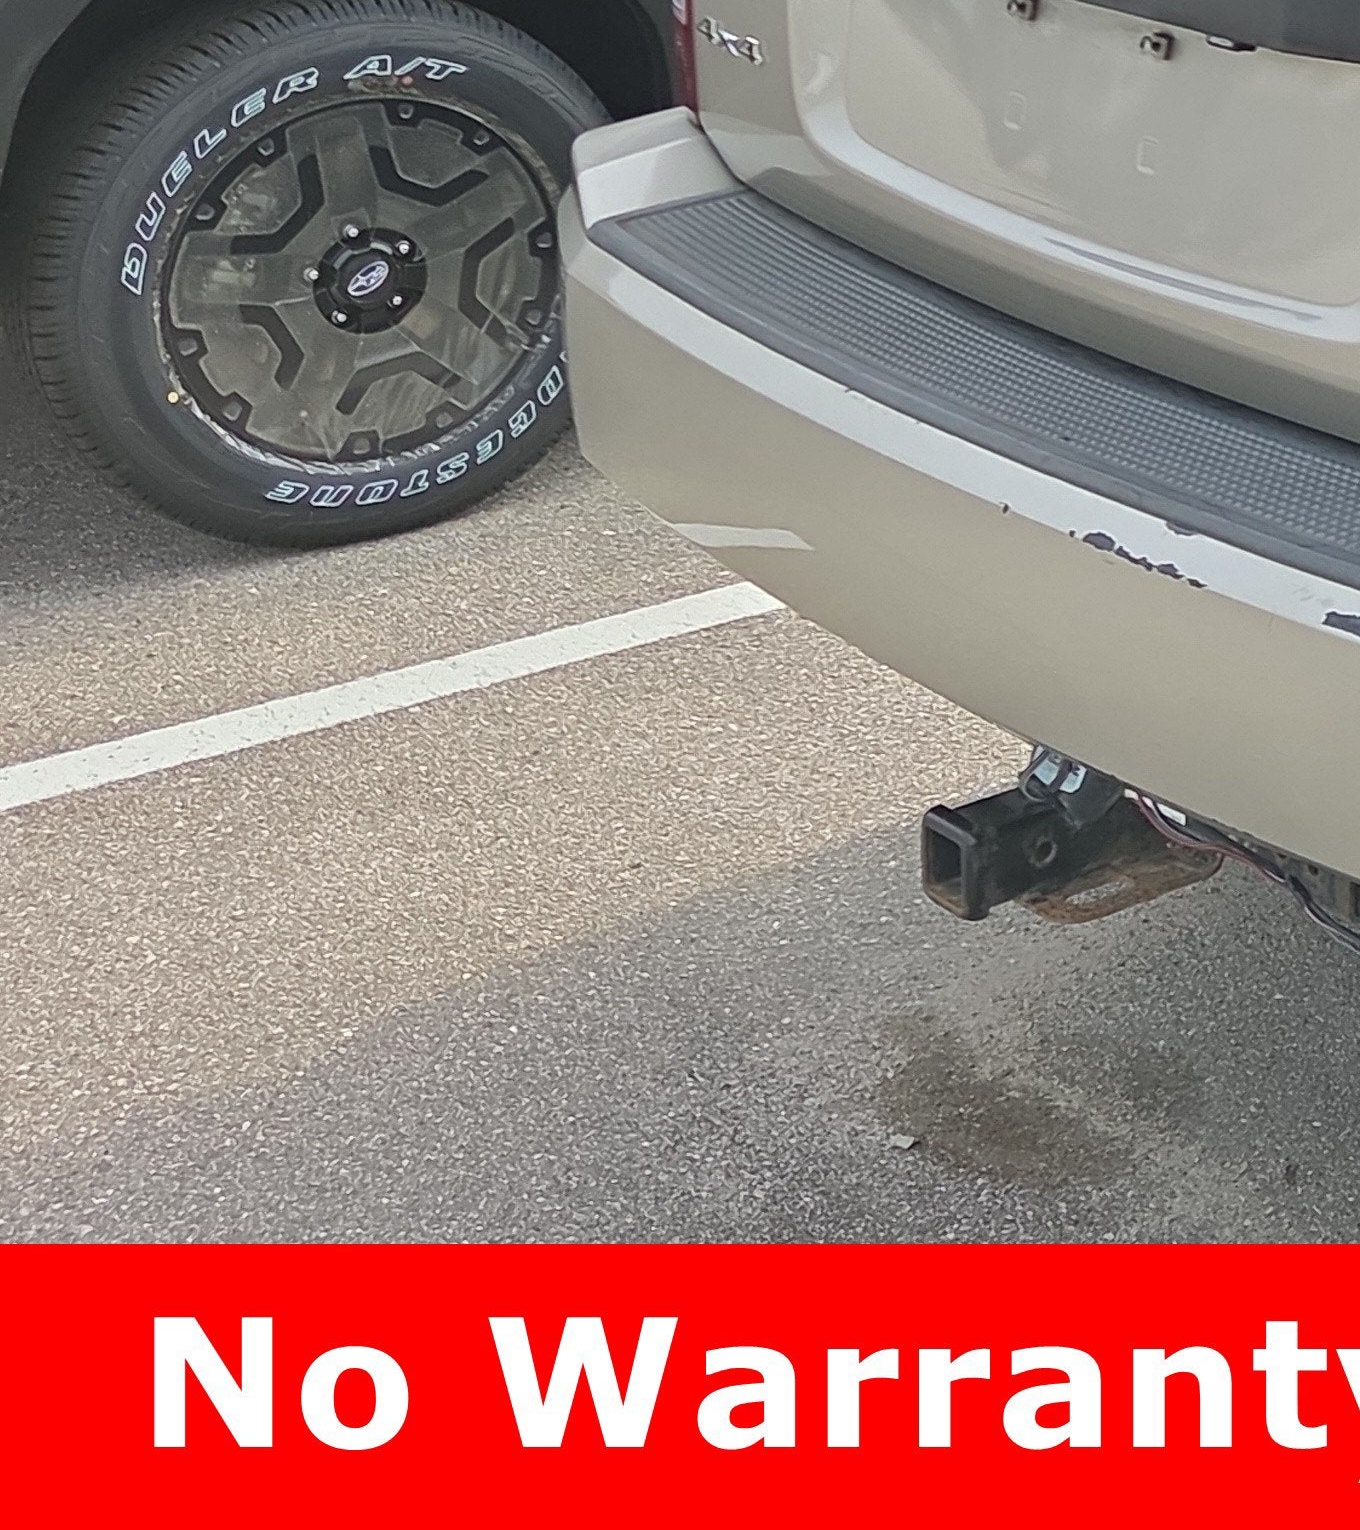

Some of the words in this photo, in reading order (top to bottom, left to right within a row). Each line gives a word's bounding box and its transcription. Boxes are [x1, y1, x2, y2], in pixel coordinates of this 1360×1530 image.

[120, 67, 318, 295] DUELER
[344, 55, 466, 80] A/T
[266, 351, 568, 508] DGESTONE
